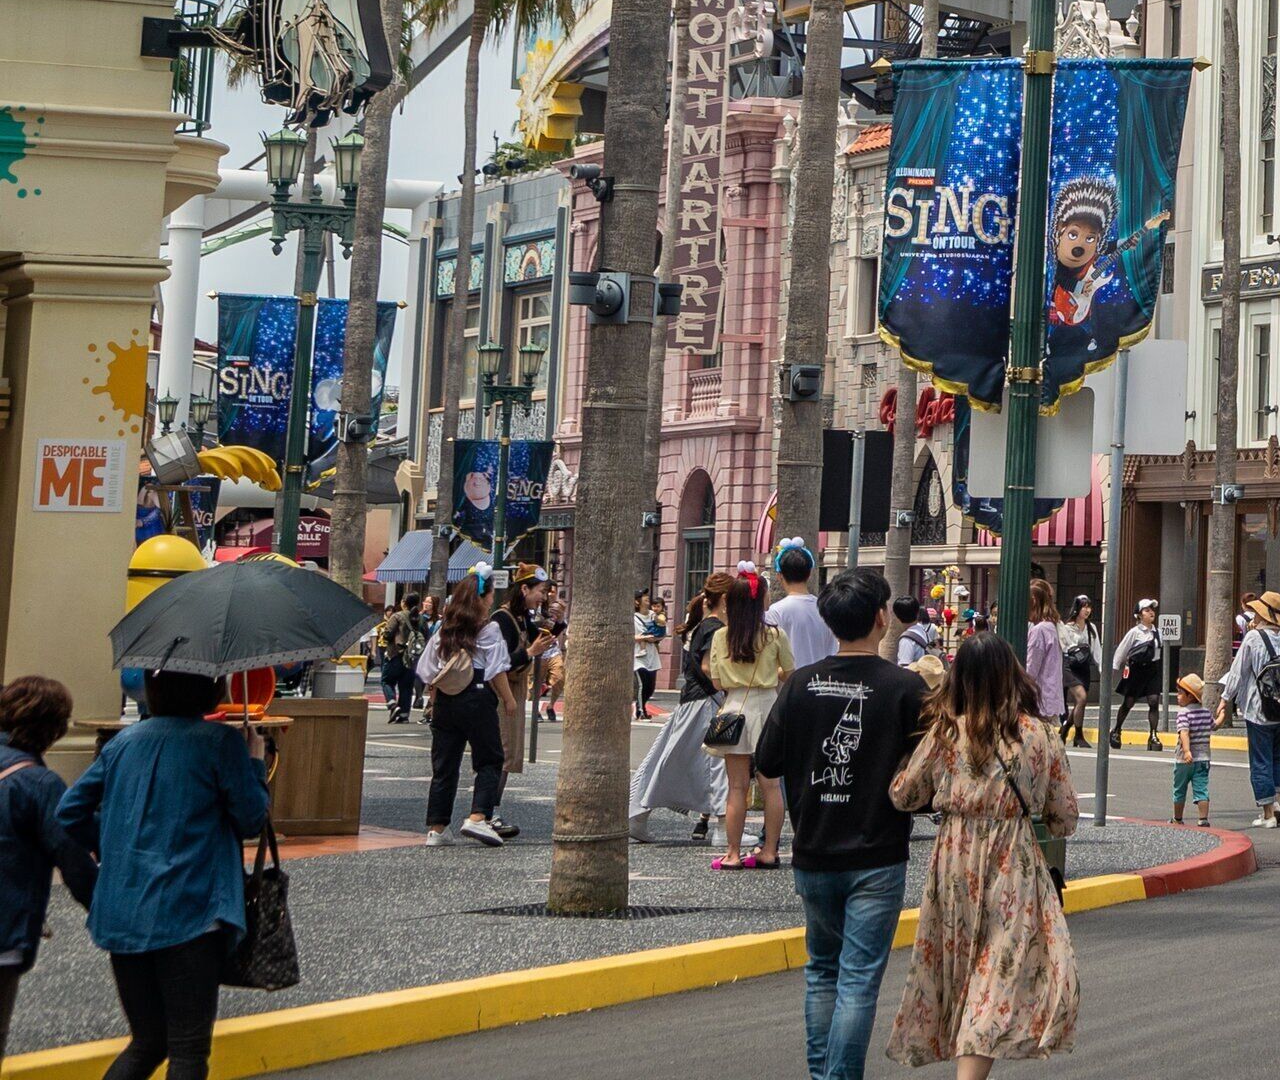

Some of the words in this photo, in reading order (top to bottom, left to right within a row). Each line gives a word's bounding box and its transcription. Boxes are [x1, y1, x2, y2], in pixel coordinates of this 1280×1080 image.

[885, 186, 1012, 245] SING
[932, 237, 946, 250] ON
[948, 236, 976, 250] TOUR
[219, 366, 288, 400] SING
[43, 445, 107, 458] DESPICABLE
[39, 458, 107, 506] ME
[1163, 619, 1177, 627] TAXI
[1162, 628, 1178, 636] ZONE
[821, 794, 851, 802] HELMUT
